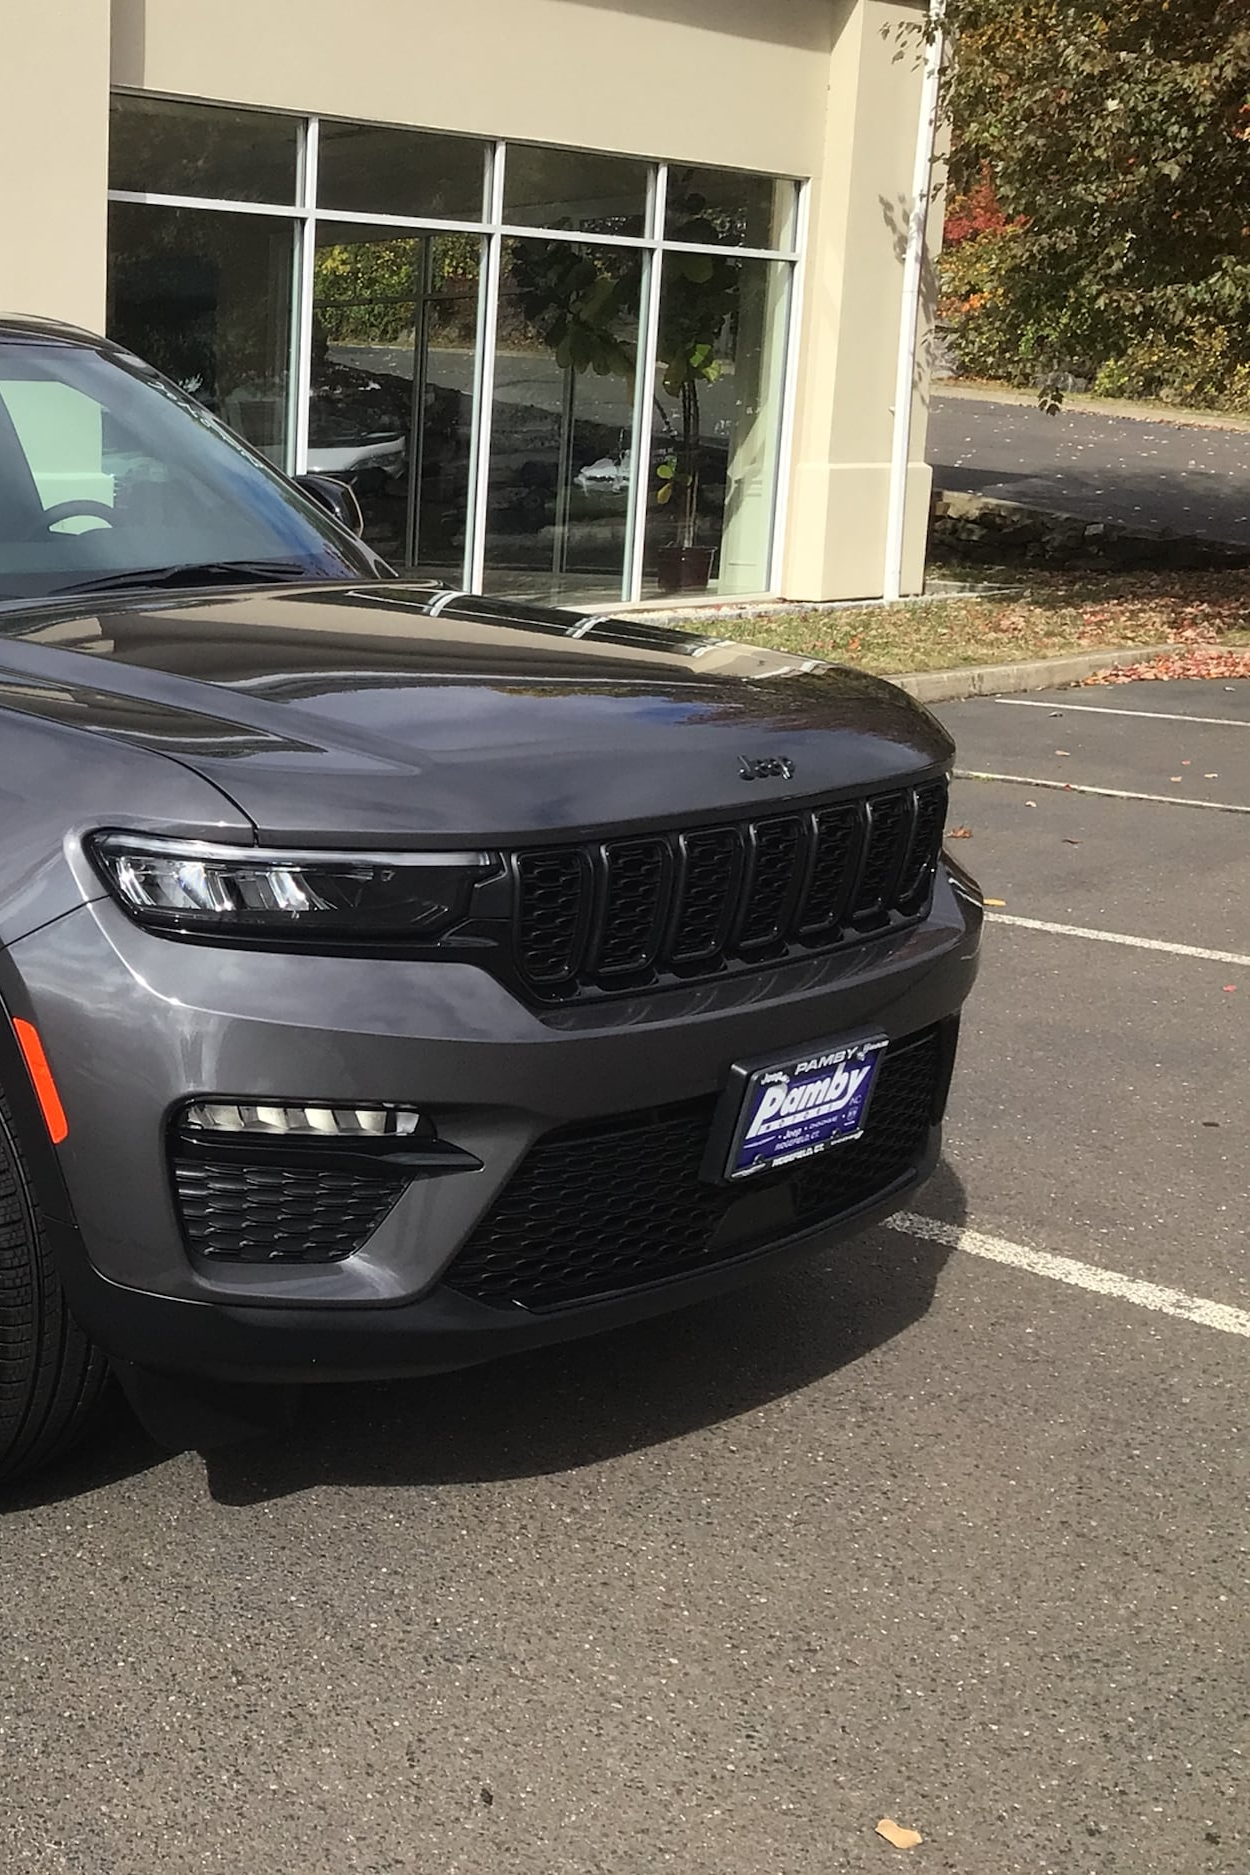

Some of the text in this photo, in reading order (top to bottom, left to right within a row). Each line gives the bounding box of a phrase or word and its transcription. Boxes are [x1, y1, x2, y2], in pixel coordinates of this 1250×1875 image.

[737, 754, 794, 780] Jeep
[794, 1046, 858, 1075] PAMBY
[745, 1062, 871, 1140] Pamby
